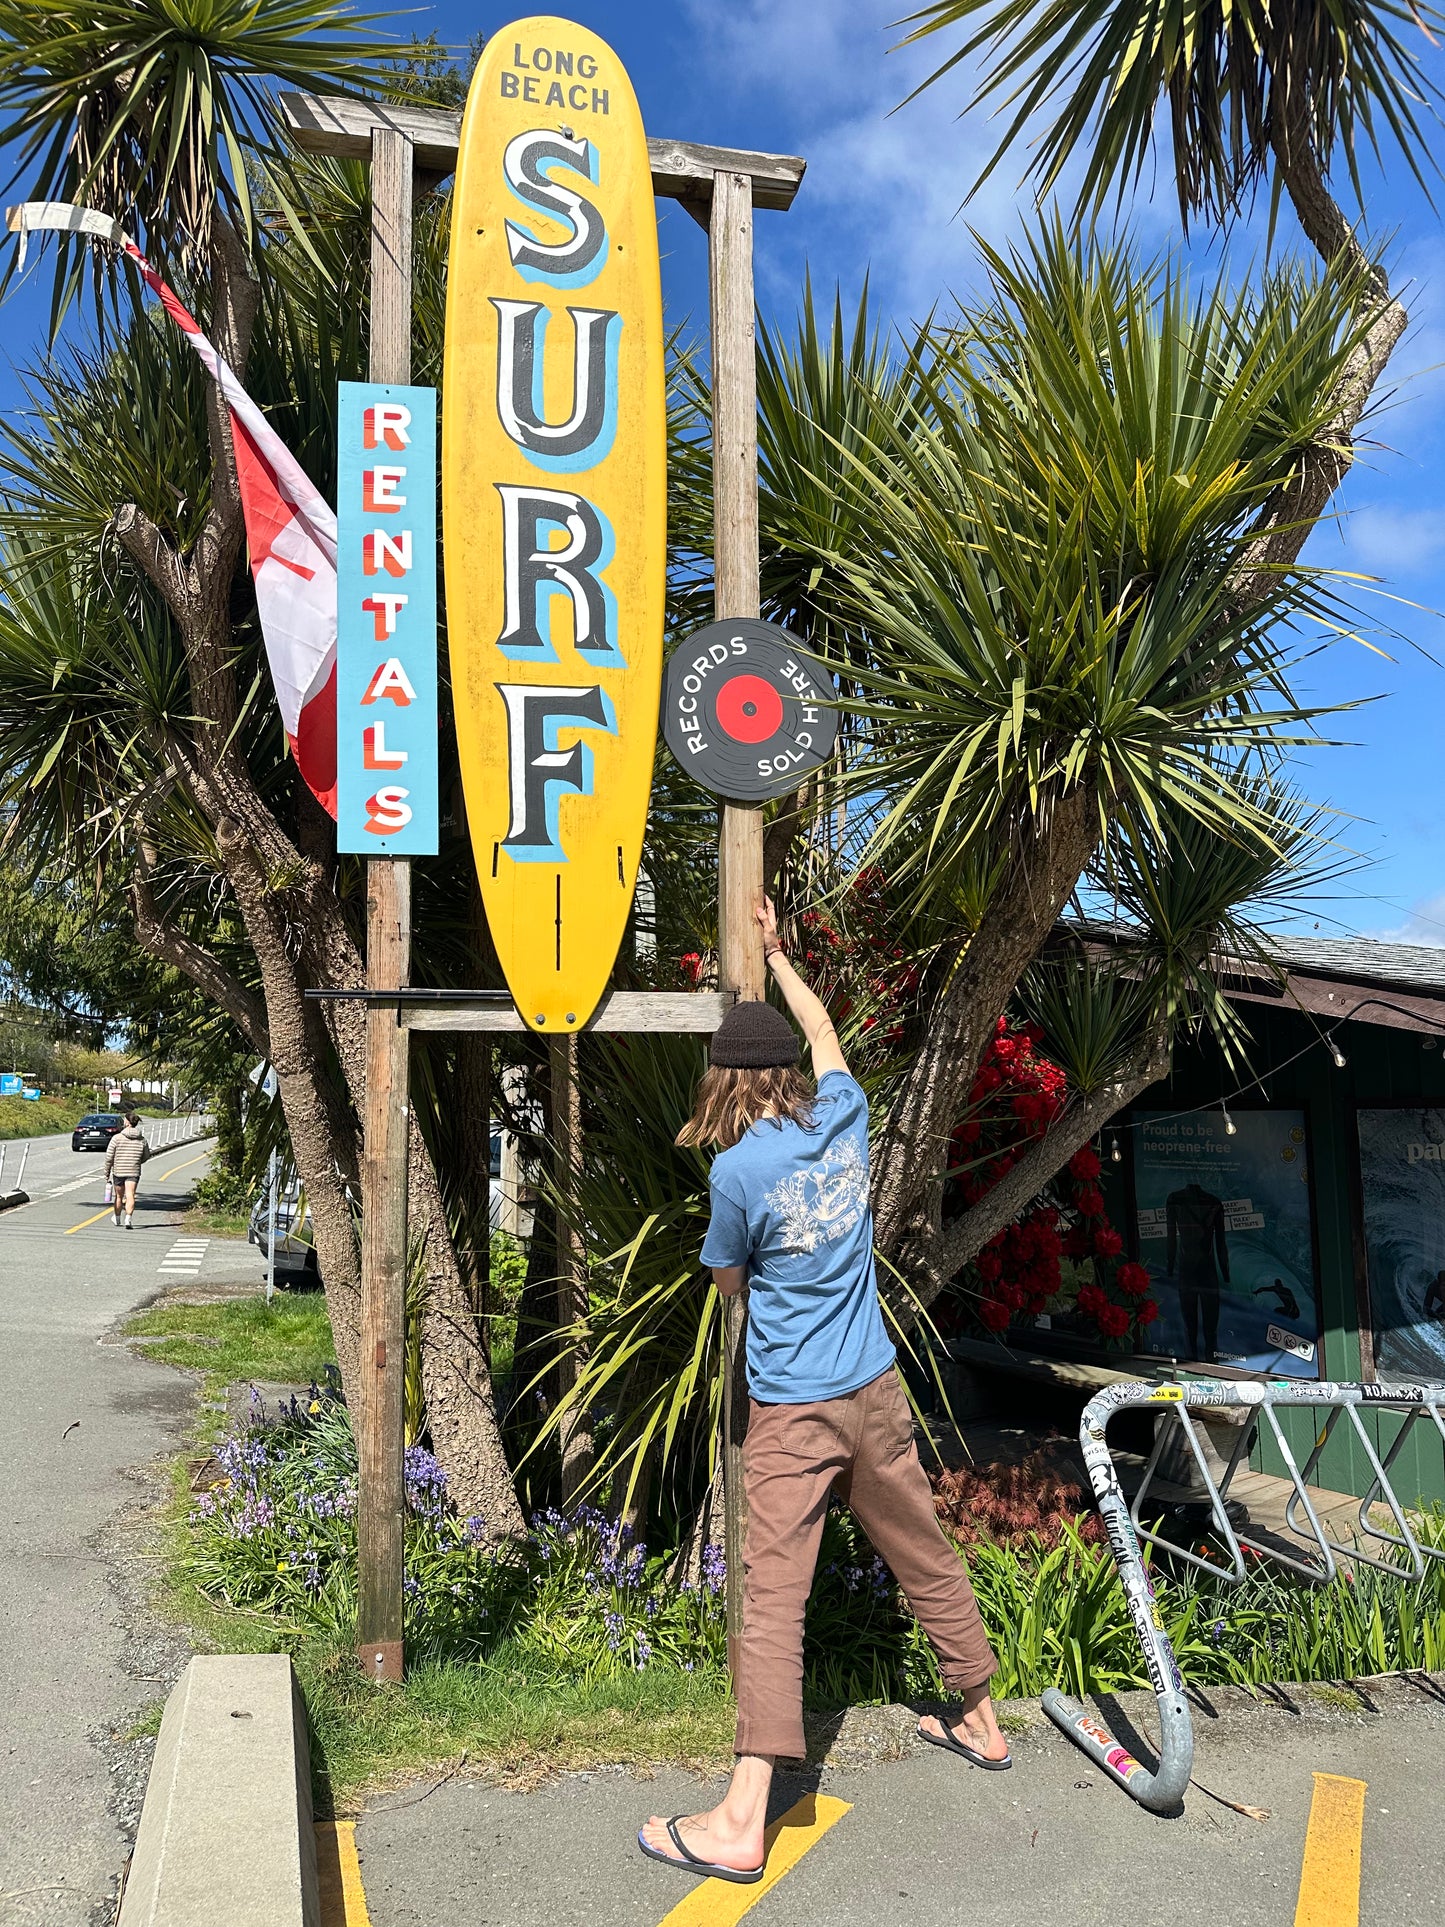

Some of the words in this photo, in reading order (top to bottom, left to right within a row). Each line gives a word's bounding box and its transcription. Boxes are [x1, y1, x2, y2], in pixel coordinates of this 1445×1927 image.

[514, 43, 598, 79] LONG
[501, 71, 610, 115] BEACH
[488, 129, 627, 862] SURF
[361, 402, 417, 835] RENTALS
[678, 636, 748, 755] RECORDS
[779, 659, 819, 723] HERE
[757, 731, 813, 776] SOLD
[1142, 1123, 1178, 1136] Proud
[1181, 1125, 1194, 1136] to
[1197, 1124, 1214, 1136] be
[1143, 1140, 1232, 1155] neoprene-free
[1213, 1351, 1247, 1362] patagonia
[1190, 1394, 1223, 1405] ISLAND
[1103, 1509, 1134, 1566] VULCAN
